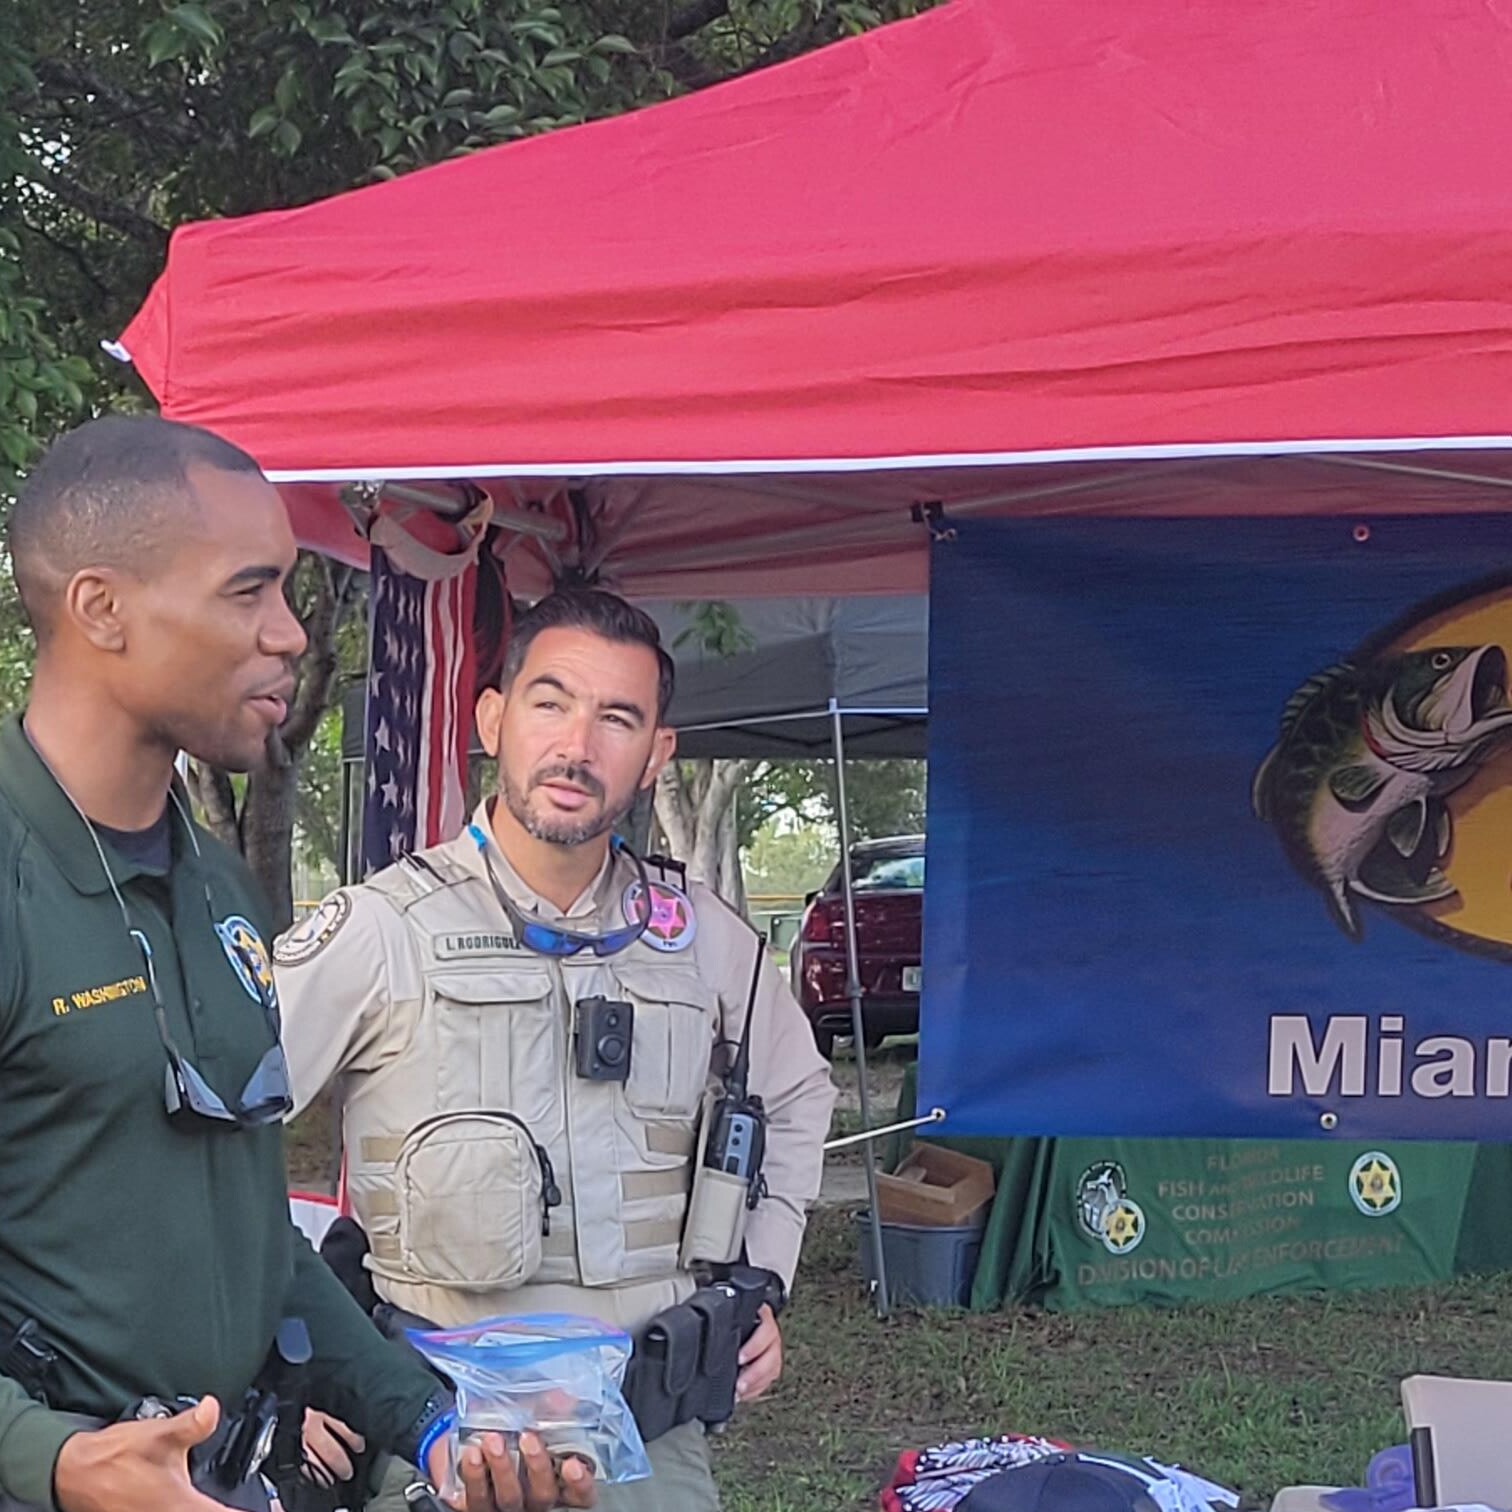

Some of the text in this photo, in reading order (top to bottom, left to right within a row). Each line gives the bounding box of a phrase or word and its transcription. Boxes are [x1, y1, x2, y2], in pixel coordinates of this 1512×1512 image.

[53, 975, 146, 1015] R. WASHINGTON
[1268, 1015, 1512, 1097] Mia
[1157, 1180, 1205, 1198] FISH
